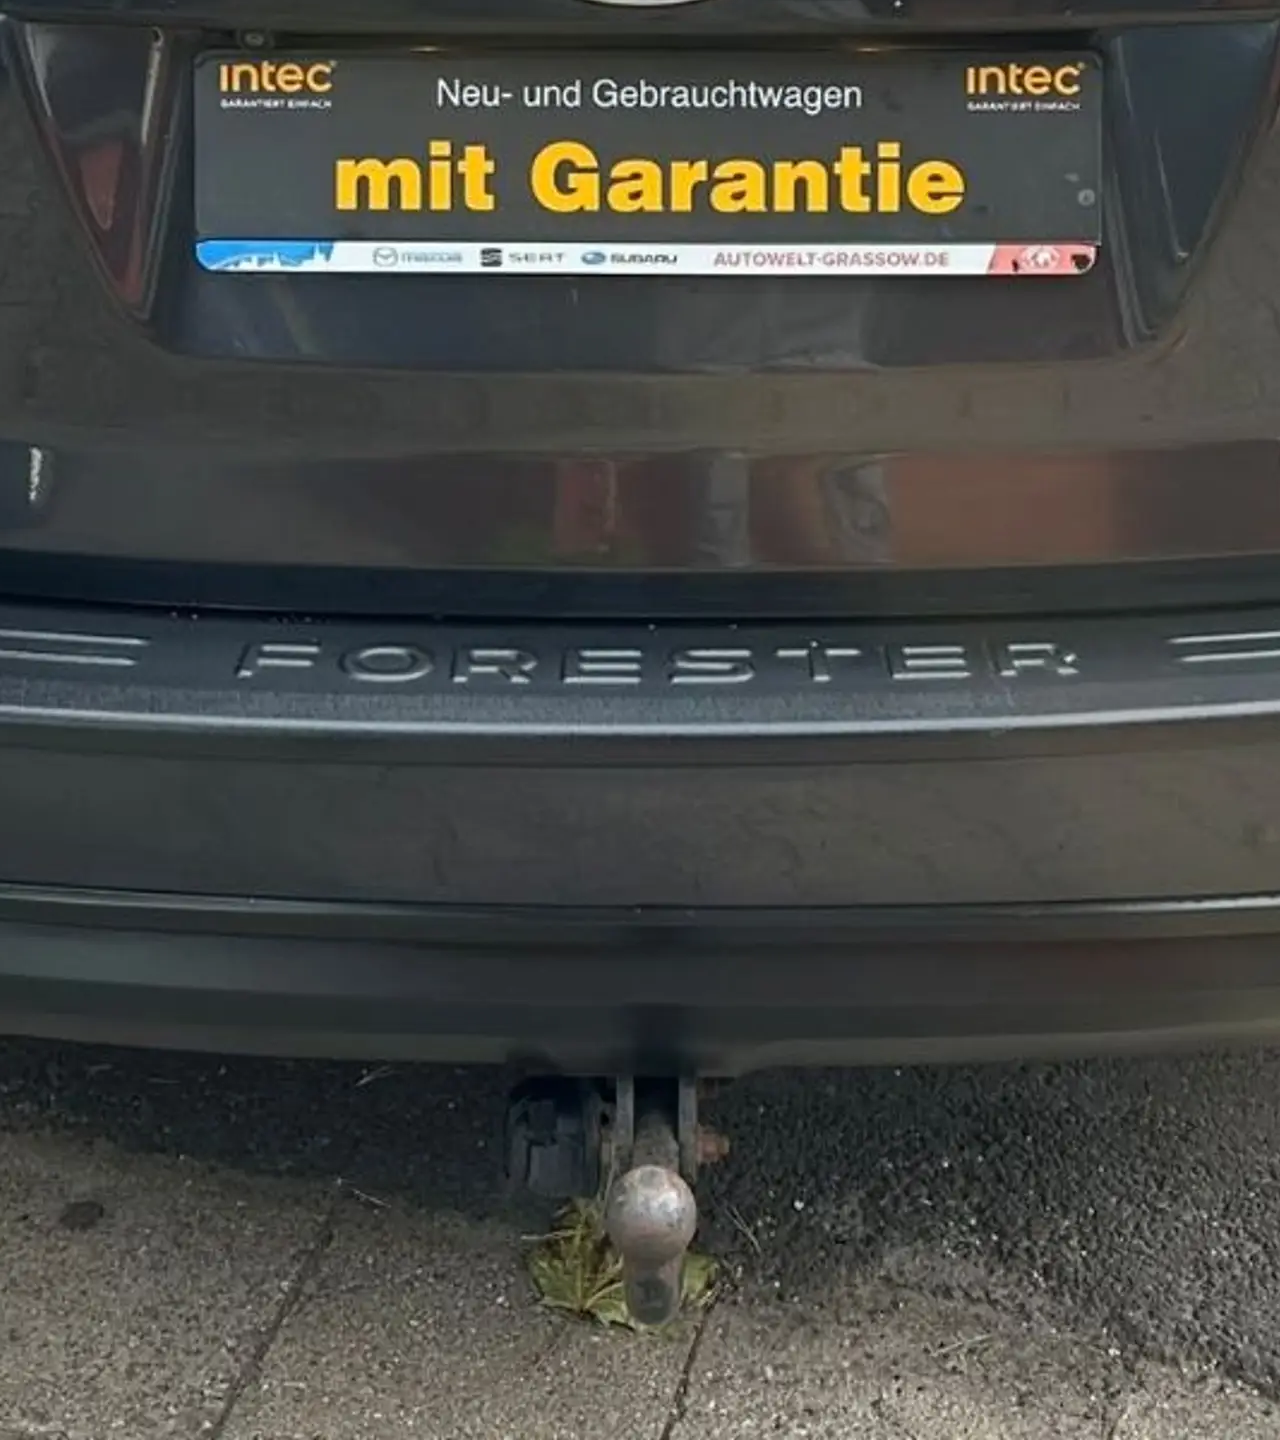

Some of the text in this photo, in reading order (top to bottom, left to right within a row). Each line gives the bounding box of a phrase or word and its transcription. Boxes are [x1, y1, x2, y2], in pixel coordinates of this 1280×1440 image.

[220, 60, 332, 93] intec
[966, 63, 1081, 95] intec
[436, 78, 863, 115] Neu- und Gebrauchtwagen
[335, 140, 965, 213] mit Garantie
[713, 250, 950, 268] AUTOWELT-GRASSOW.DE
[236, 642, 1081, 684] FORESTER
